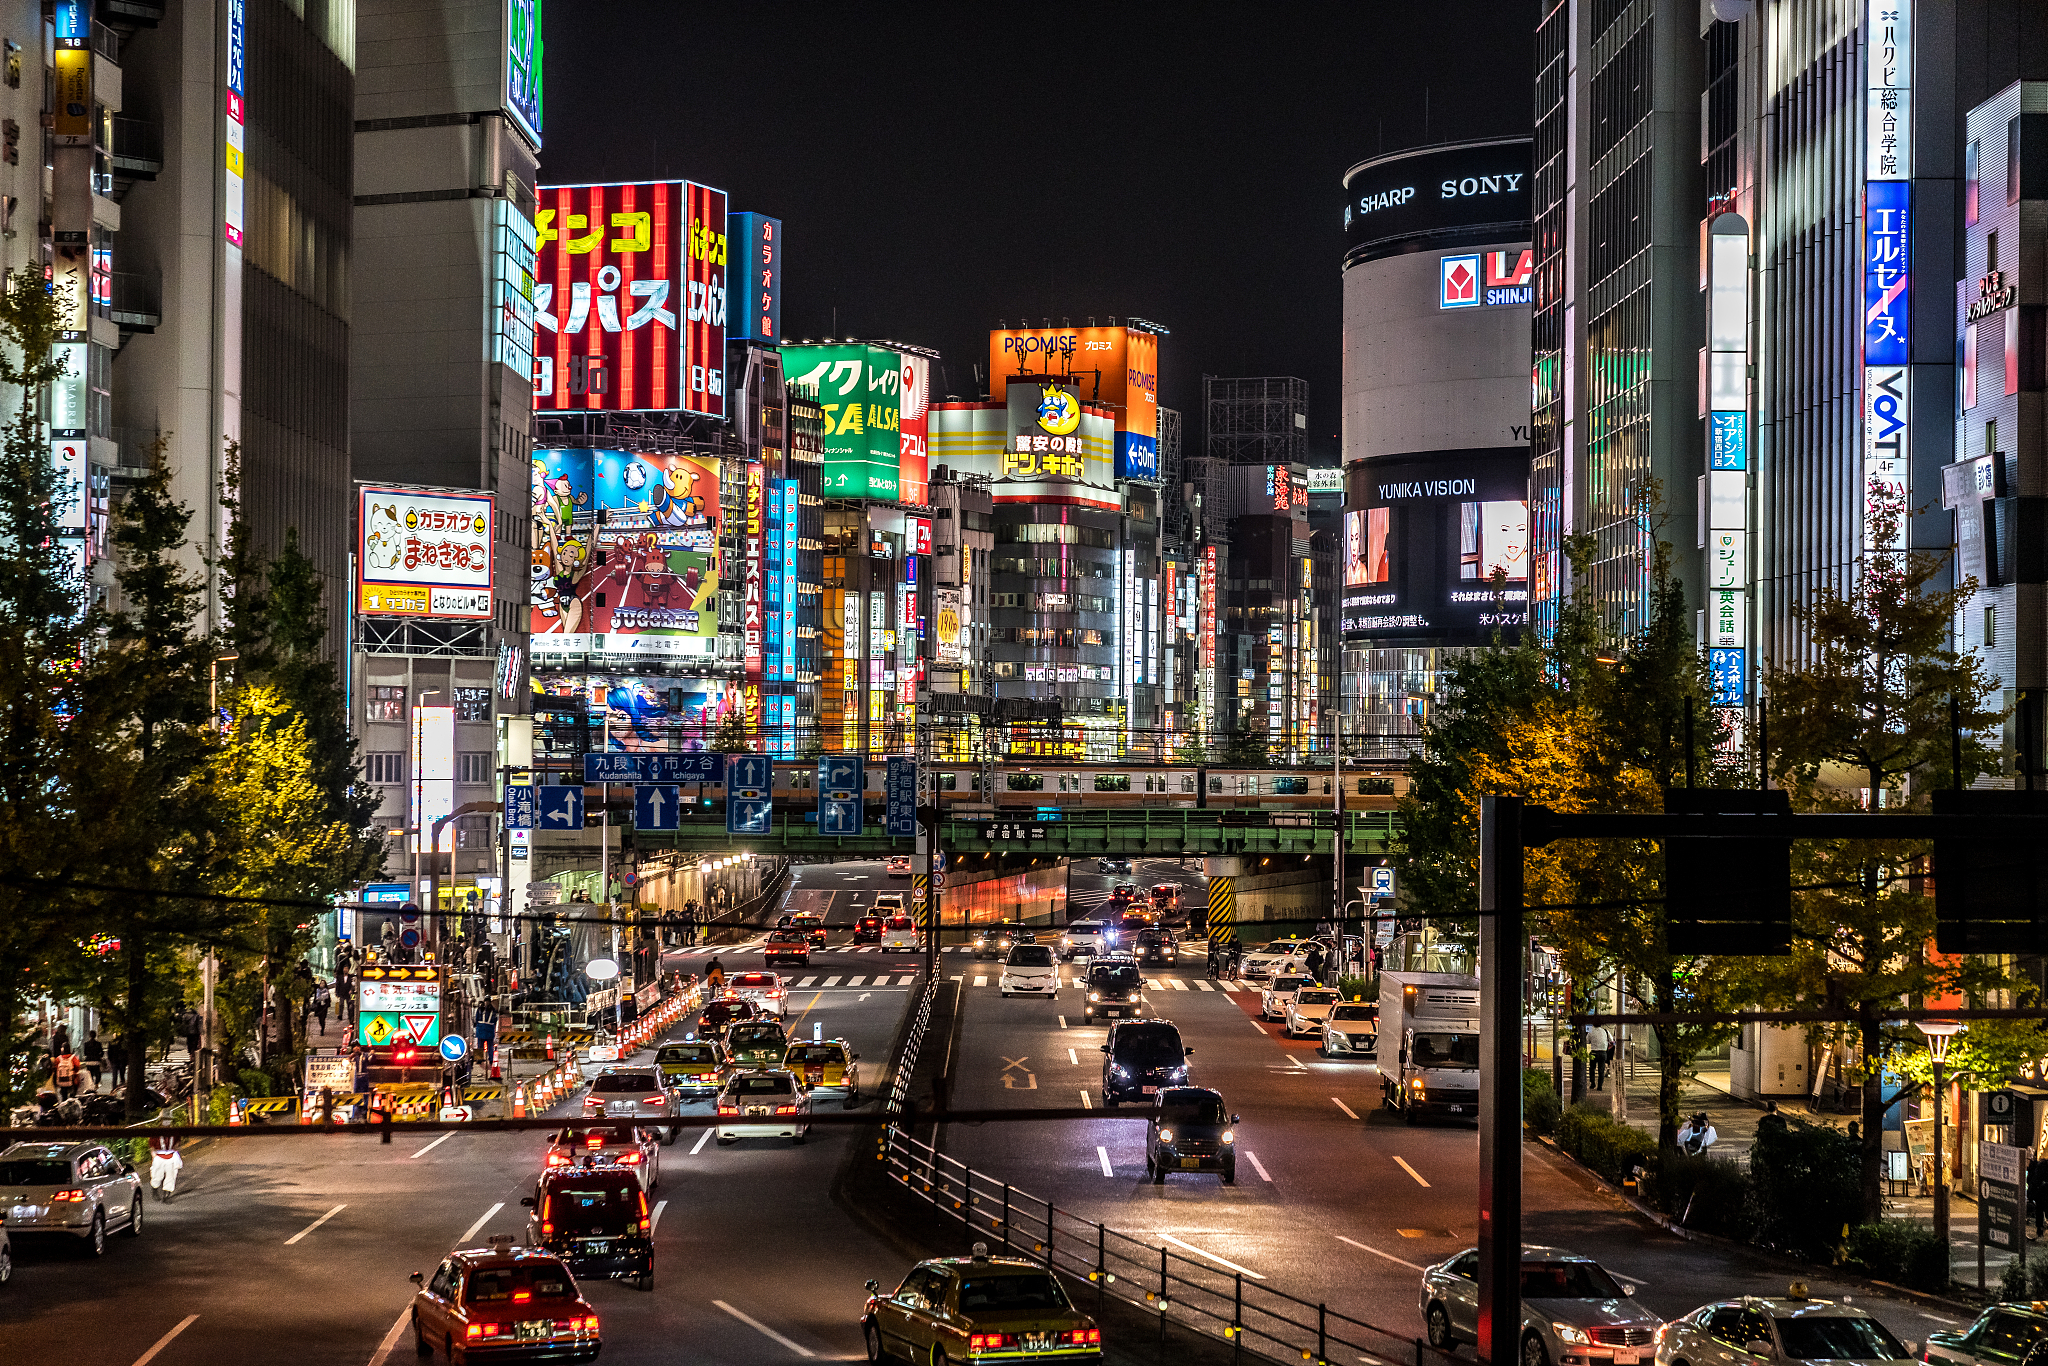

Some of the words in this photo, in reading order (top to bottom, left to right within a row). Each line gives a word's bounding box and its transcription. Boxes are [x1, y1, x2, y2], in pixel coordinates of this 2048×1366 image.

[1880, 26, 1898, 176] ハクビ総合学院
[66, 135, 78, 144] 7F
[1441, 172, 1524, 199] SONY
[1360, 186, 1415, 215] SHARP
[688, 217, 727, 267] パチンコ
[760, 221, 775, 338] カラオケ館
[1871, 208, 1900, 345] エルセーヌ
[687, 274, 727, 327] エスパス
[61, 331, 79, 340] 5F
[1004, 335, 1078, 353] PROMISE
[1084, 340, 1113, 351] プロミス
[691, 365, 723, 397] 日拓
[868, 364, 899, 396] レイク
[1128, 368, 1155, 392] PROMISE
[867, 403, 899, 433] ALSA
[62, 429, 76, 438] 4F
[900, 432, 927, 458] アコム
[1723, 414, 1738, 467] オアシス
[1137, 445, 1155, 470] 50m
[1714, 427, 1723, 467] 新宿西口店
[1878, 460, 1895, 472] 4F
[1379, 481, 1423, 500] YUNIKA
[1424, 478, 1475, 497] VISION
[747, 470, 760, 535] パチンコ
[419, 511, 472, 531] カラオケ
[404, 535, 486, 571] まねきねこ
[385, 597, 427, 612] ワンカラ
[432, 594, 470, 611] となりのビル
[610, 605, 700, 633] JUGGLER
[845, 602, 855, 650] 小松ビル
[551, 638, 582, 648] 北電子
[654, 640, 681, 650] 北電子
[595, 756, 647, 771] 九段下
[599, 771, 642, 781] Kudanshita
[672, 771, 705, 781] Ichigaya
[890, 762, 900, 799] Shinjuku
[516, 787, 532, 828] 小滝橋
[899, 761, 912, 832] 新宿駅東口
[506, 808, 516, 827] Brdg.
[986, 829, 1026, 839] 新宿駅
[380, 983, 438, 995] 電気工事中
